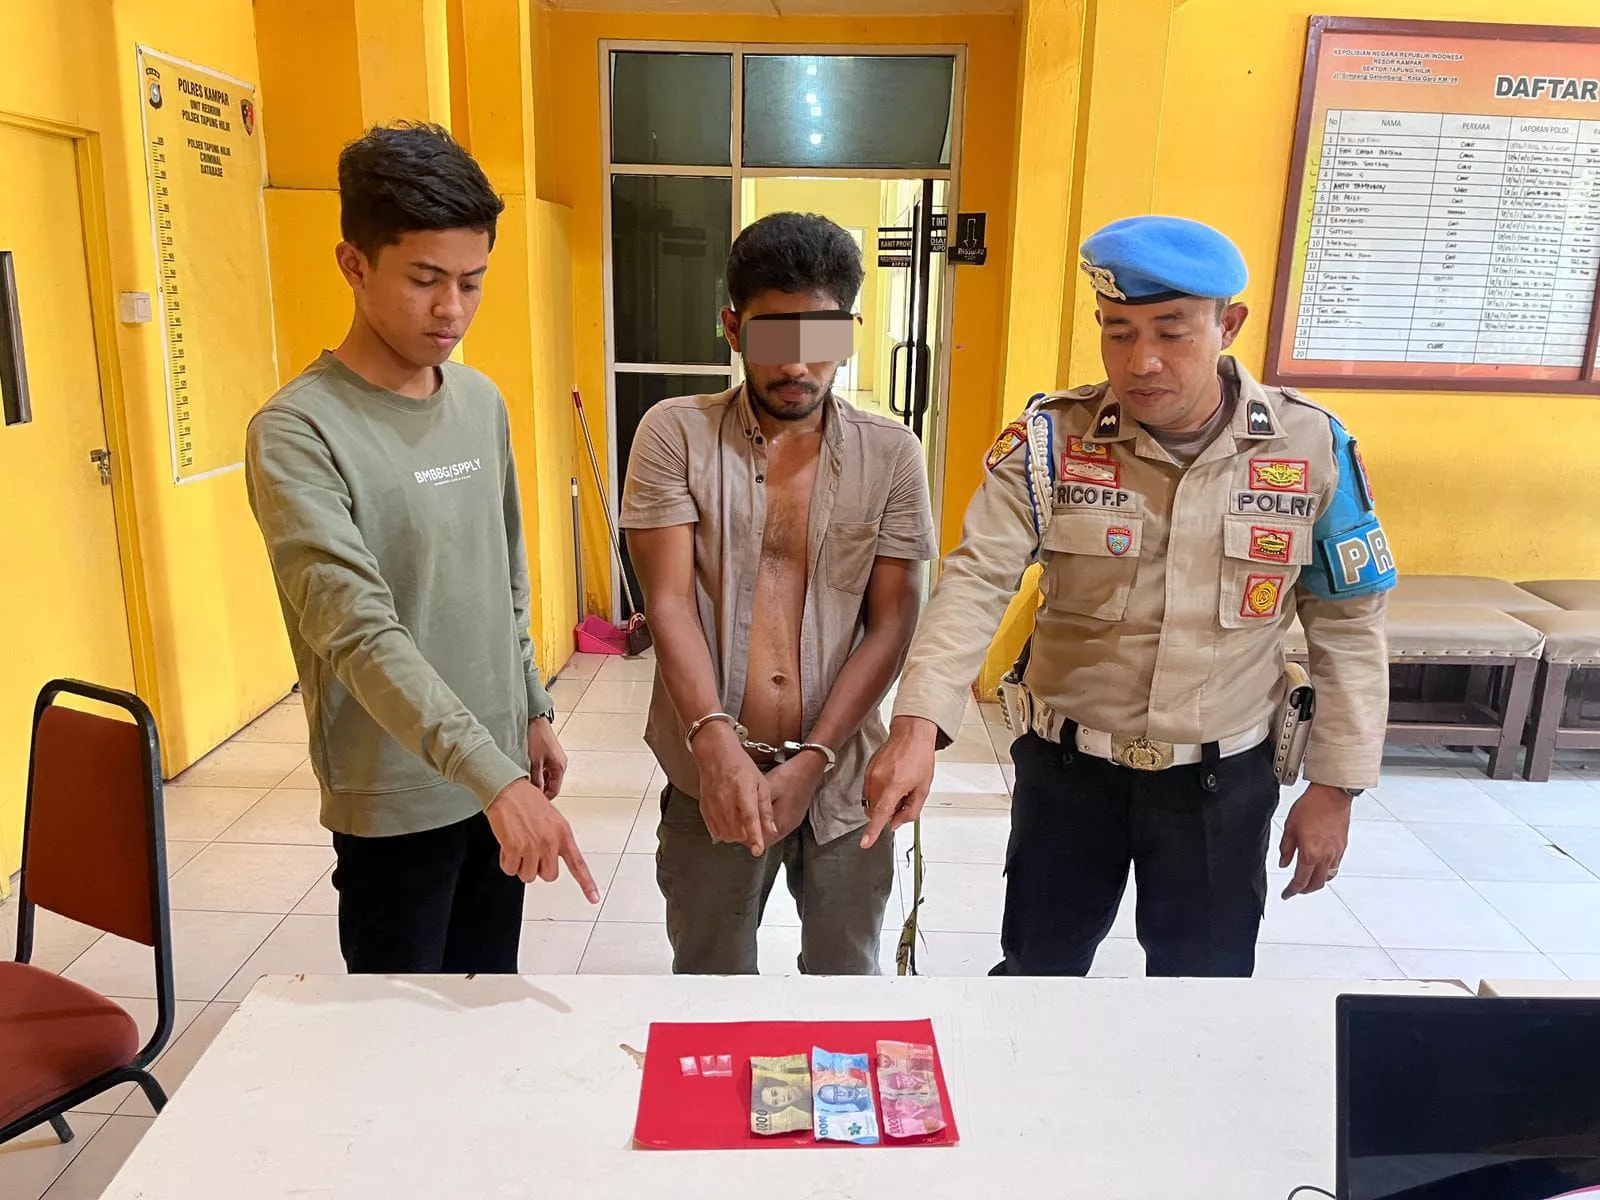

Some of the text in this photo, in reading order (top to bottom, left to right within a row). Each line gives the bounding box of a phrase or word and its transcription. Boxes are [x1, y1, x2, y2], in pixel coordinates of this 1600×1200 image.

[178, 77, 230, 106] POLRES KAMPAR
[1496, 76, 1599, 100] DAFTAR
[190, 99, 200, 110] UNIT
[182, 110, 230, 132] POLSEK TAPUNG HILIR
[1462, 122, 1490, 131] PERKARA
[1520, 125, 1548, 134] LAPORAN
[1550, 126, 1569, 134] POLISI
[187, 138, 204, 150] POLSEK
[204, 141, 220, 154] TAPUNG
[200, 152, 222, 166] CRIMINAL
[201, 164, 224, 178] DATABASE
[1058, 486, 1128, 507] RICO F.P
